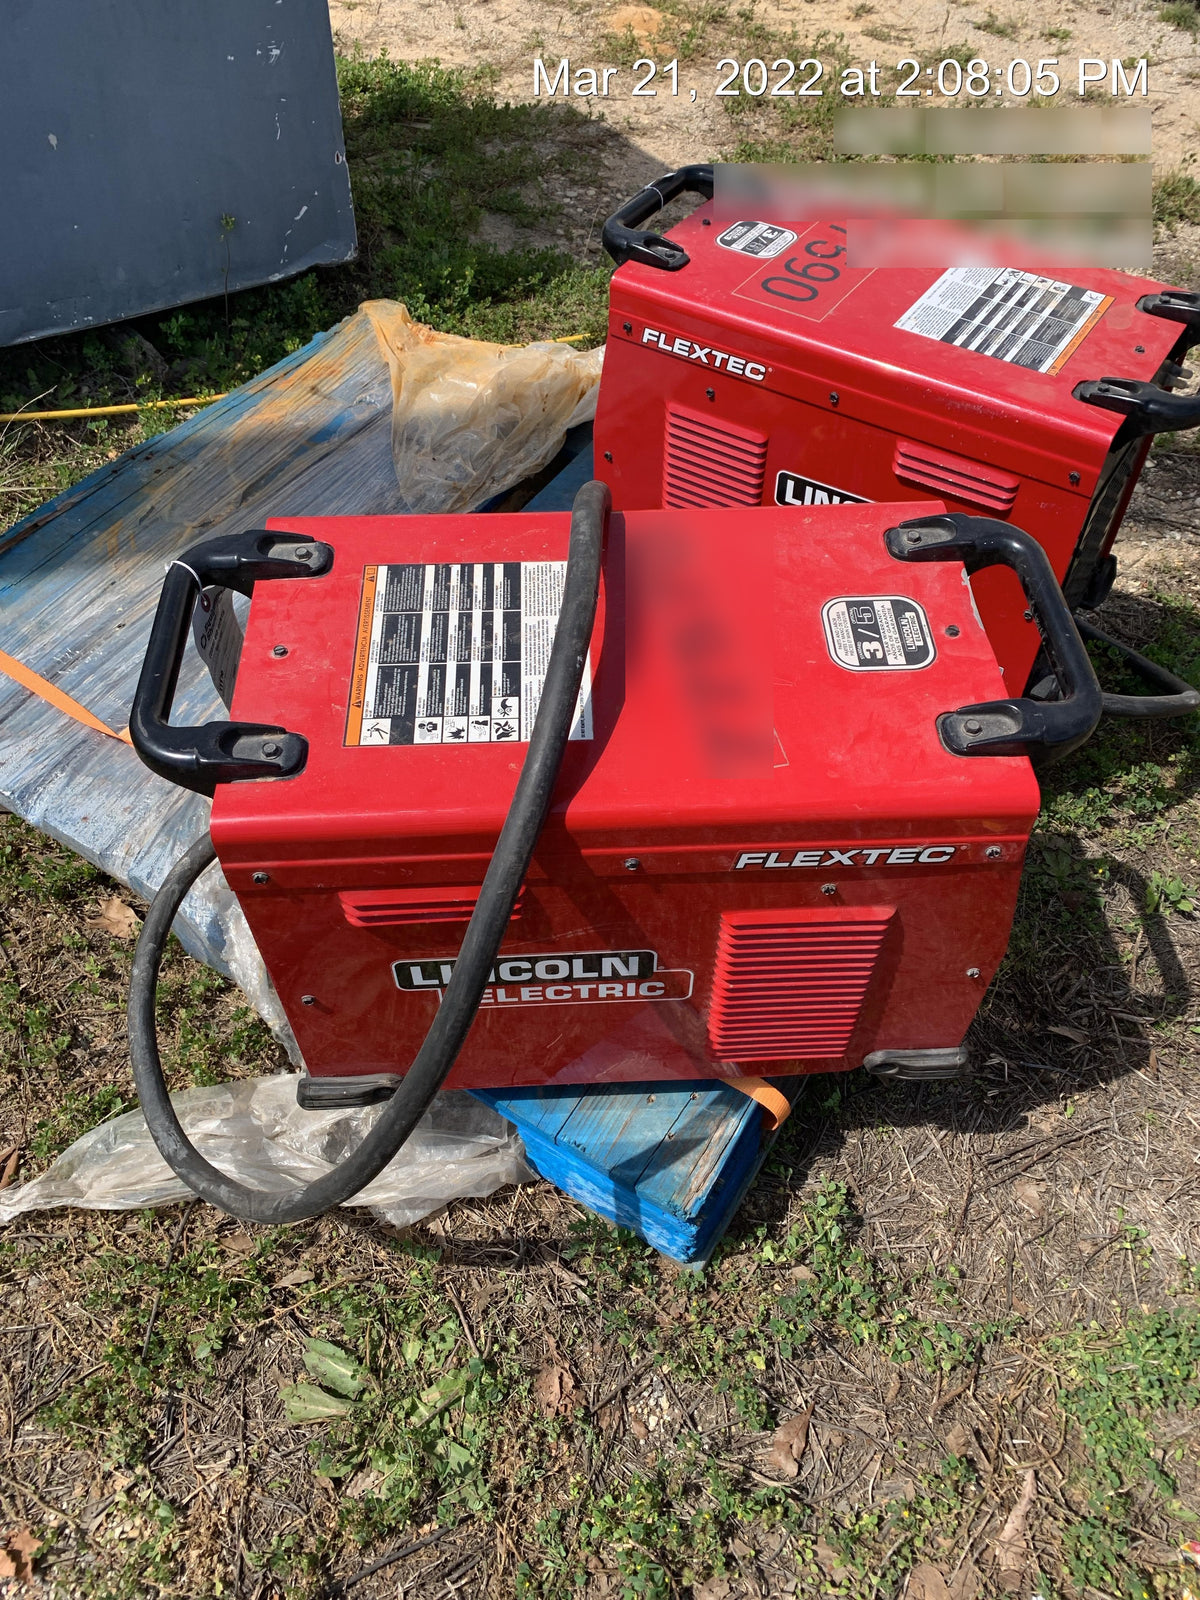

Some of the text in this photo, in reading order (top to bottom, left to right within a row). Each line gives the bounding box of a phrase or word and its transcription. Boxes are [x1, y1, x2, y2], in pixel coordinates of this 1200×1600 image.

[642, 327, 766, 382] FLEXTEC
[900, 619, 915, 649] LINCOLN
[909, 616, 921, 641] ELECTRIC
[735, 846, 955, 869] FLEXTEC
[410, 956, 640, 986] LICOLN
